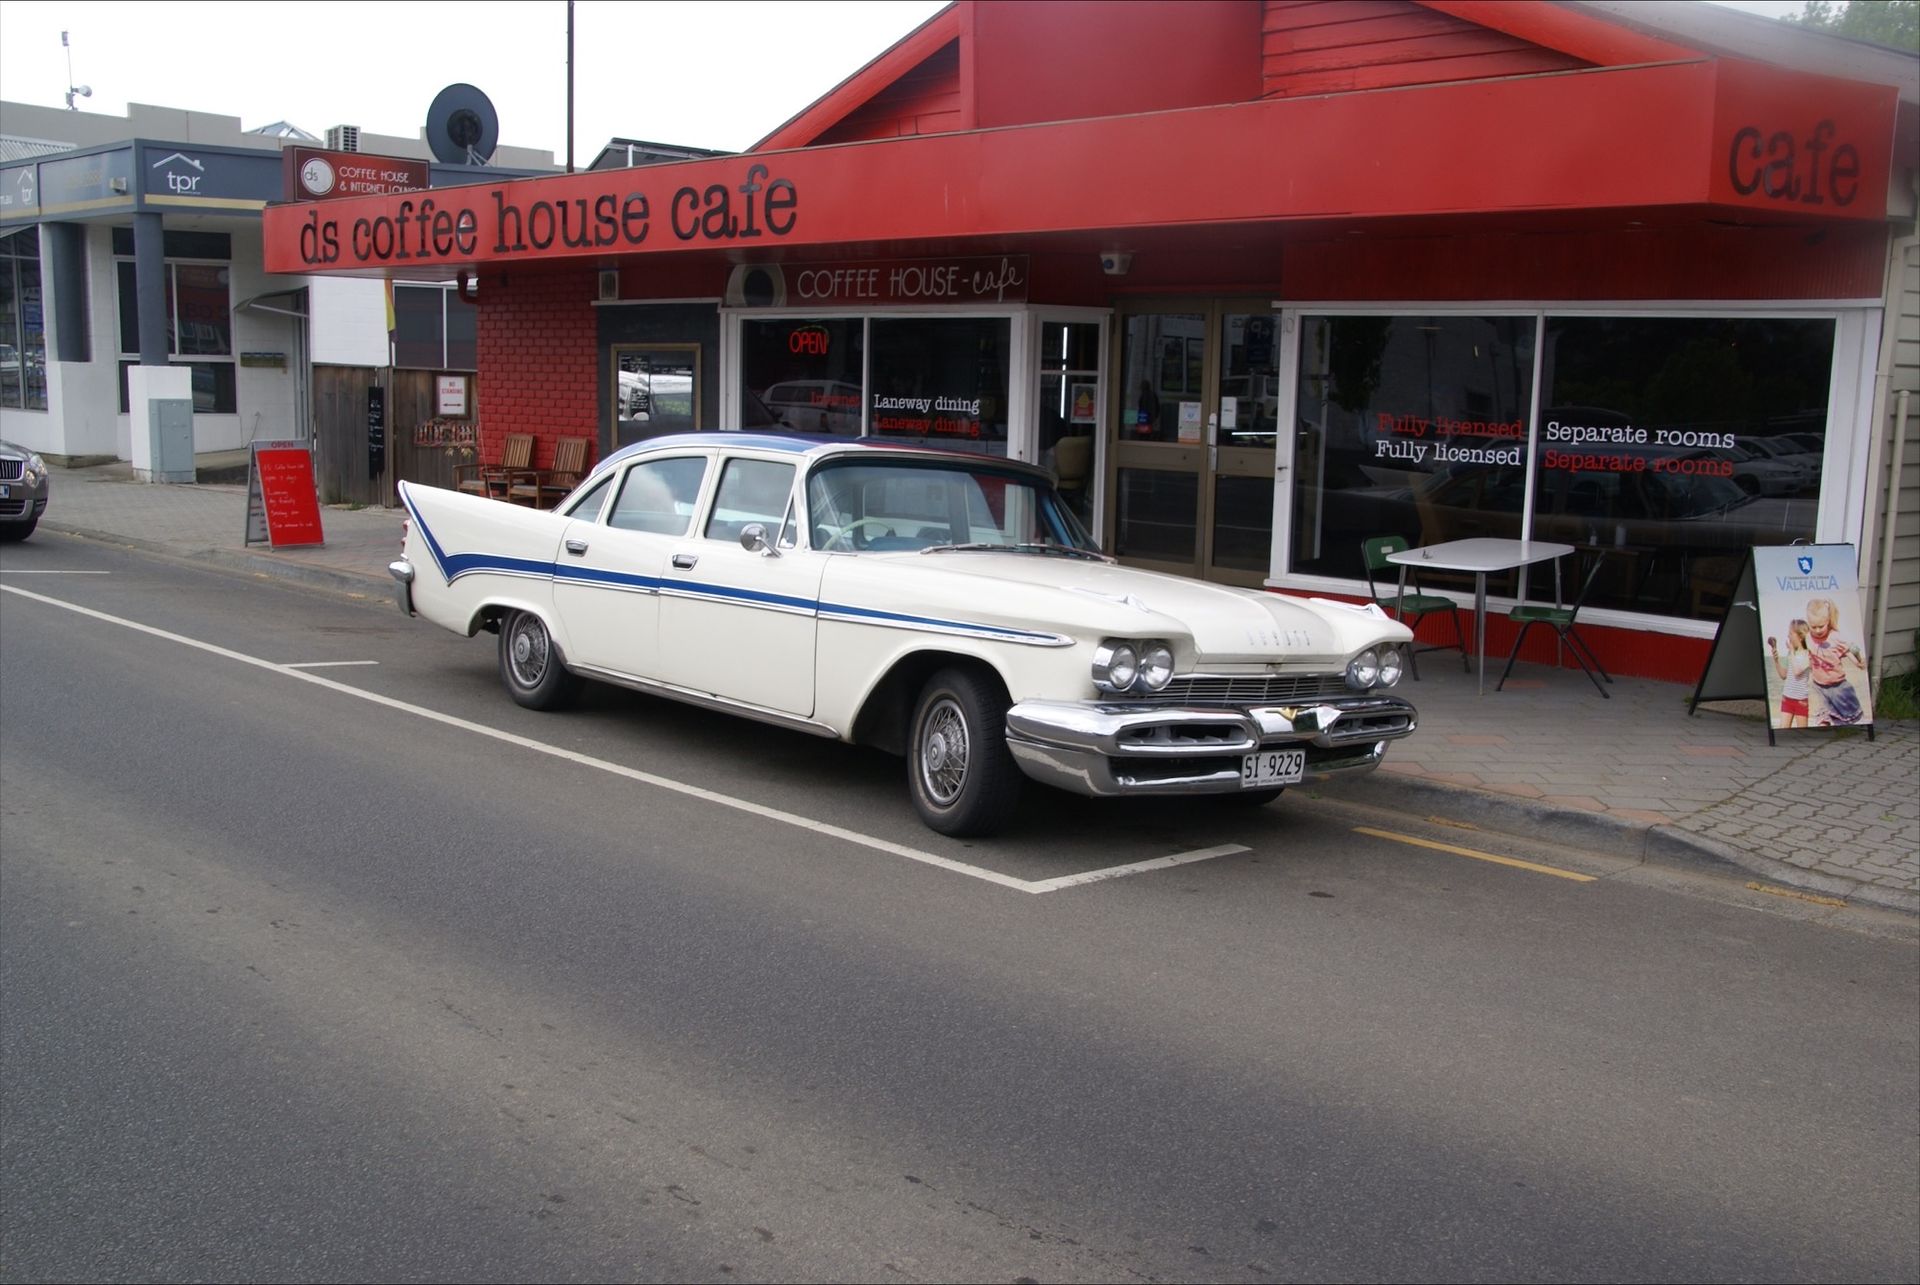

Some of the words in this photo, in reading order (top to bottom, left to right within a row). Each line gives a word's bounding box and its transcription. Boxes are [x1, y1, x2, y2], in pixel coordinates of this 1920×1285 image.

[304, 167, 319, 182] ds
[339, 166, 376, 180] COFFEE
[380, 170, 409, 183] HOUSE
[1729, 119, 1860, 207] cafe
[167, 171, 201, 193] tpr
[339, 181, 347, 191] &
[350, 182, 385, 194] INTERNET
[300, 210, 340, 264] ds
[353, 199, 478, 261] coffee
[492, 191, 649, 253] house
[671, 164, 798, 240] cafe
[797, 269, 880, 298] COFFEE
[788, 331, 828, 354] OPEN
[873, 393, 931, 412] Laneway
[934, 395, 981, 415] dining
[874, 413, 931, 433] Laneway
[934, 415, 981, 437] dining
[1376, 413, 1430, 437] Fully
[1436, 414, 1524, 438] licensed
[1546, 421, 1648, 445] Separate
[1655, 427, 1736, 449] rooms
[1375, 439, 1429, 463] Fully
[1433, 442, 1521, 466] licensed
[1544, 449, 1645, 473] Separate
[1652, 455, 1735, 477] rooms
[1776, 575, 1840, 591] VALHALLA
[1244, 755, 1260, 779] SI
[1268, 753, 1303, 777] 9229
